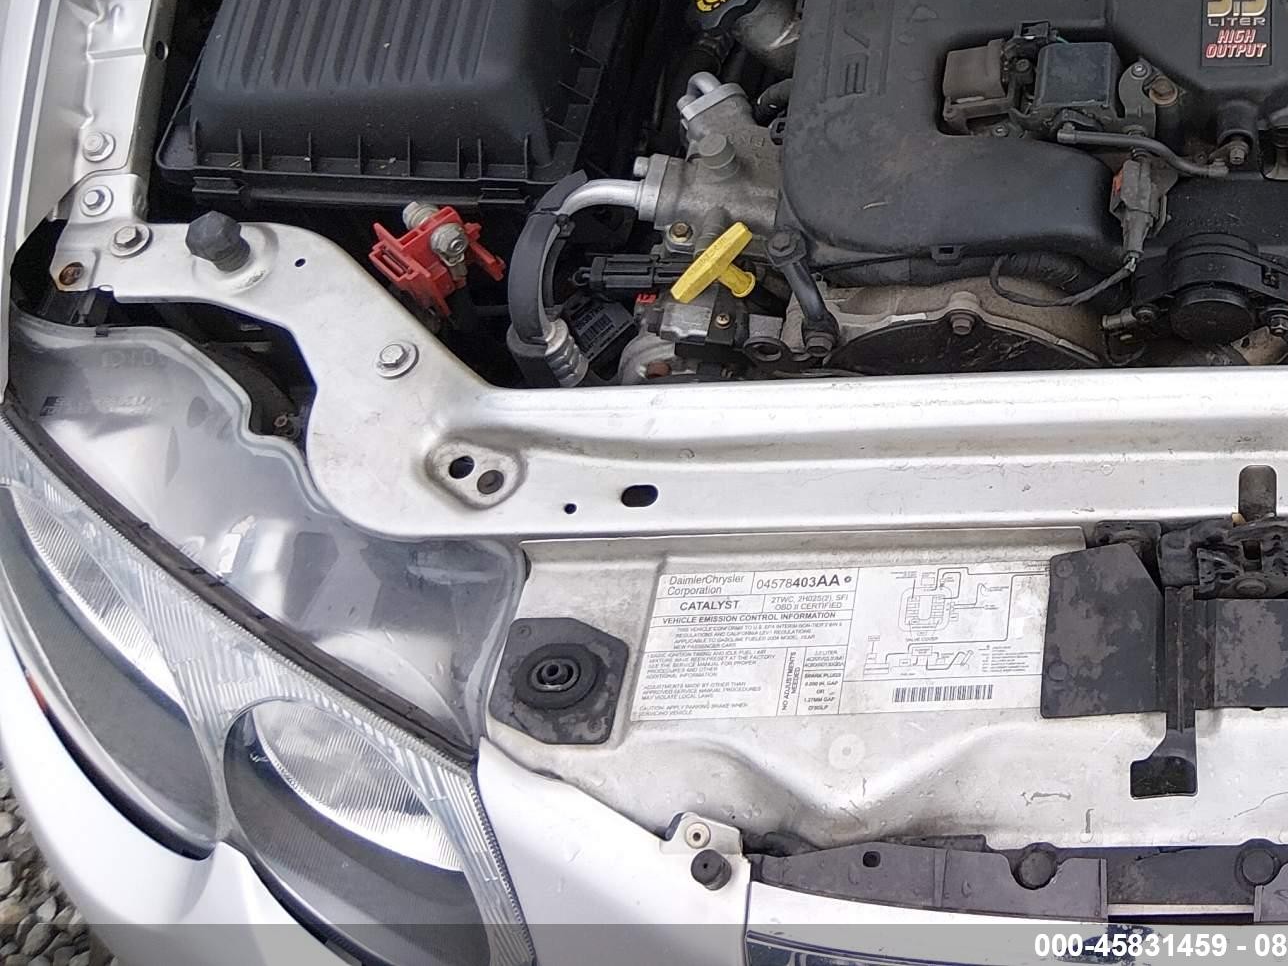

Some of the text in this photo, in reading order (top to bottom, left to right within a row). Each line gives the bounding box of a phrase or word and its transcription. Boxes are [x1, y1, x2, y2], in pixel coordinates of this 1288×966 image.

[1208, 18, 1266, 27] LITER
[1217, 29, 1256, 44] HIGH
[1206, 44, 1267, 58] OUTPUT
[669, 574, 841, 590] DaimlerChrysler 04578403AA
[667, 586, 722, 598] Corporation
[680, 600, 740, 611] CATALYST
[800, 602, 842, 610] CERTIFIED
[663, 612, 836, 625] VEHICLE EMISSION CONTROL INFORMATION
[782, 652, 797, 711] NO ADJUSTMENTS
[791, 667, 801, 694] NEEDED
